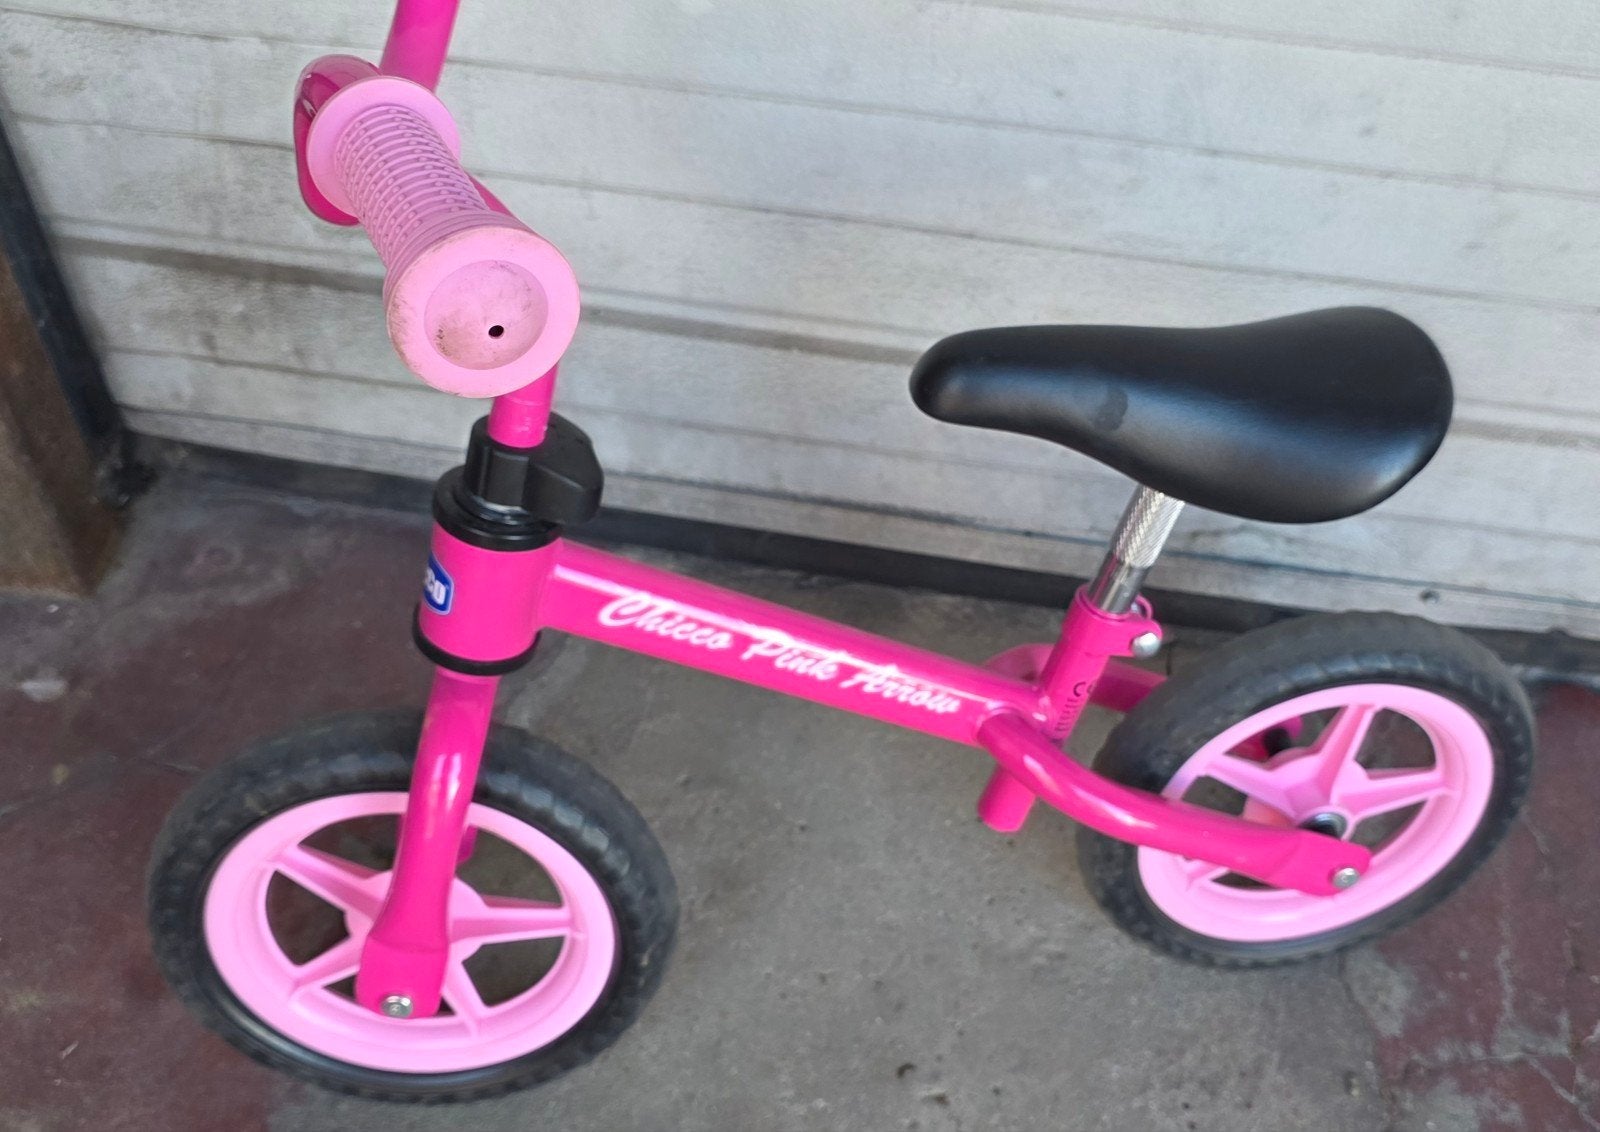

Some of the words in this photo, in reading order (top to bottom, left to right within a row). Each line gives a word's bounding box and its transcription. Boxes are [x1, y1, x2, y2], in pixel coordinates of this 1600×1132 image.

[597, 590, 733, 650] Chicco
[739, 624, 846, 681] Pink
[838, 663, 962, 714] Arrow
